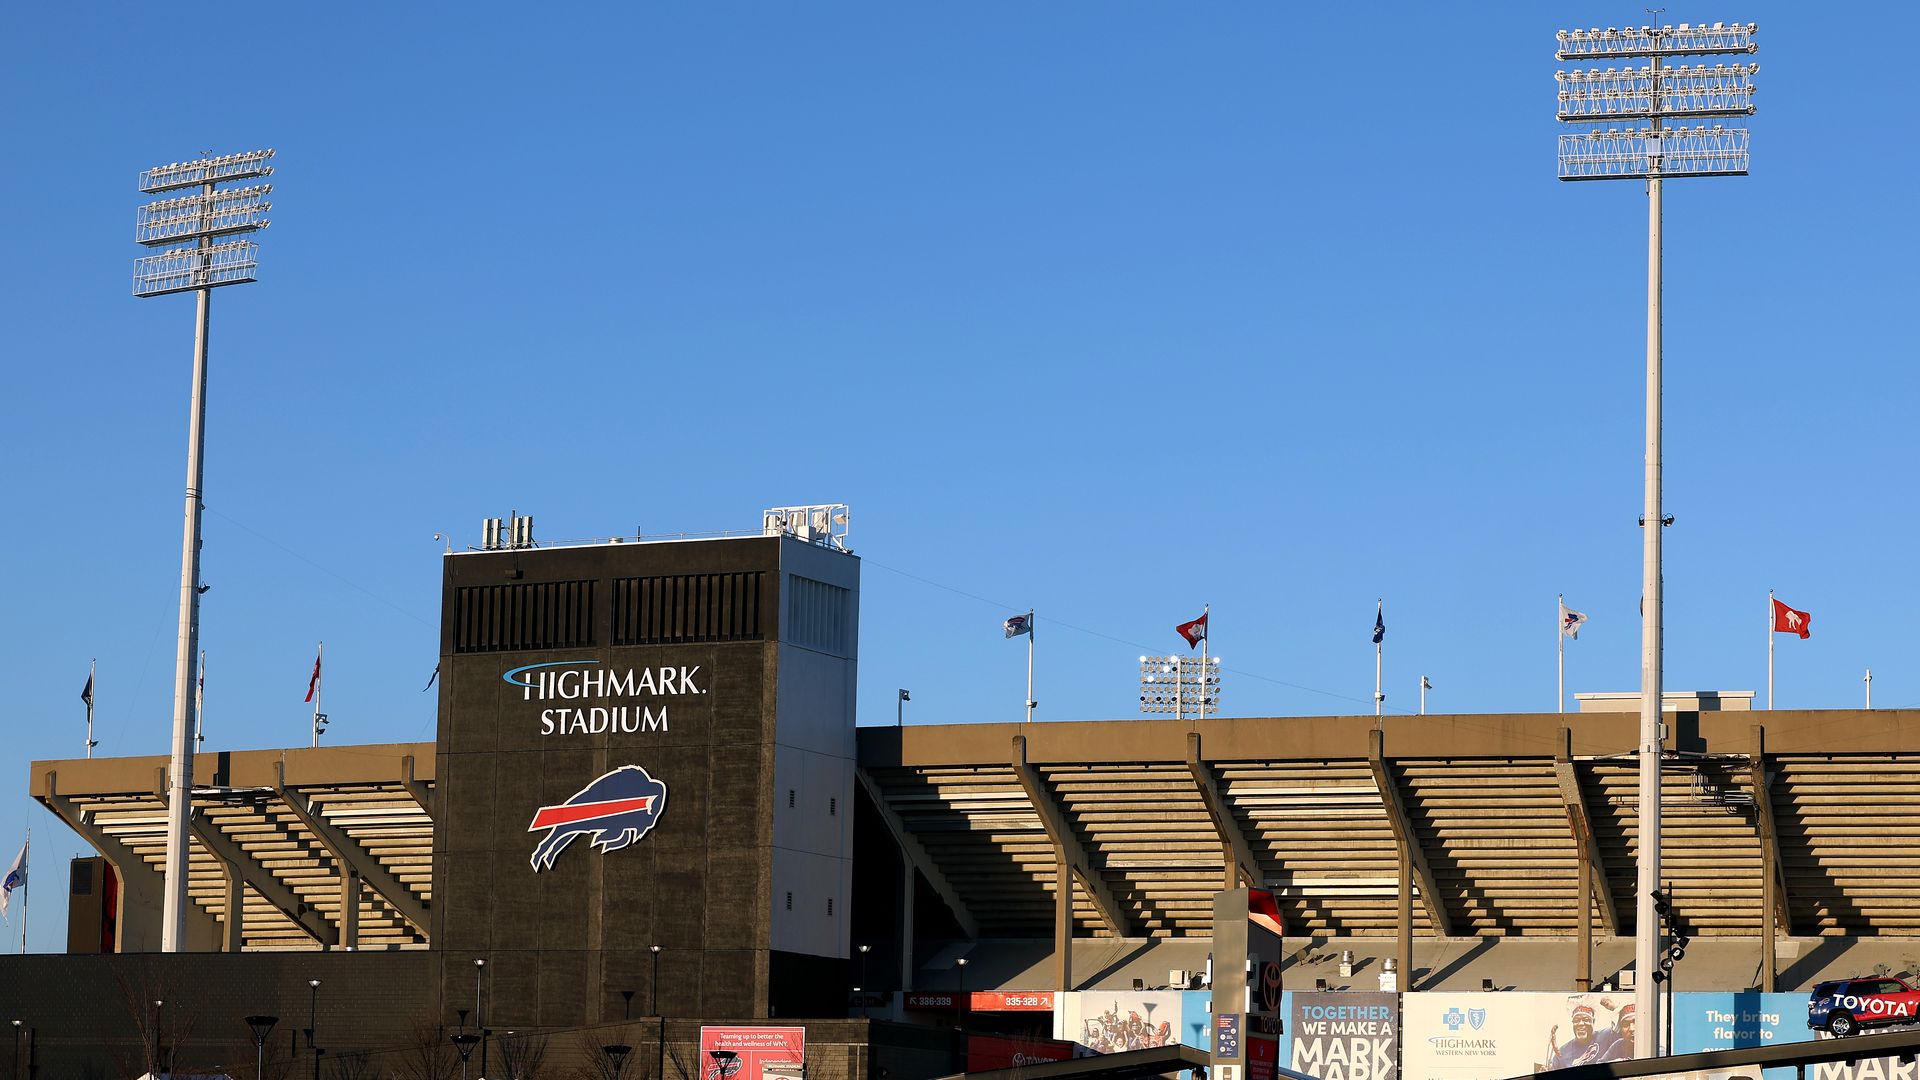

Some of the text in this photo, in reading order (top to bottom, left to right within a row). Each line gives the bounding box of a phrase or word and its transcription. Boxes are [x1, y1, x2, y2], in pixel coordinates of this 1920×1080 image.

[541, 705, 669, 735] STADIUM
[919, 997, 951, 1006] 336-339
[1005, 997, 1038, 1006] 335-328
[1833, 994, 1909, 1016] TOYOTA
[1302, 1006, 1393, 1022] TOGETHER,
[1706, 1010, 1780, 1026] They bring
[1260, 1016, 1283, 1033] TOYOTA
[1302, 1022, 1392, 1035] WE MAKE A
[720, 1033, 741, 1041] Teaming
[1713, 1027, 1773, 1039] flavor to
[1435, 1039, 1496, 1048] HIGHMARK
[1814, 1054, 1920, 1080] MAR
